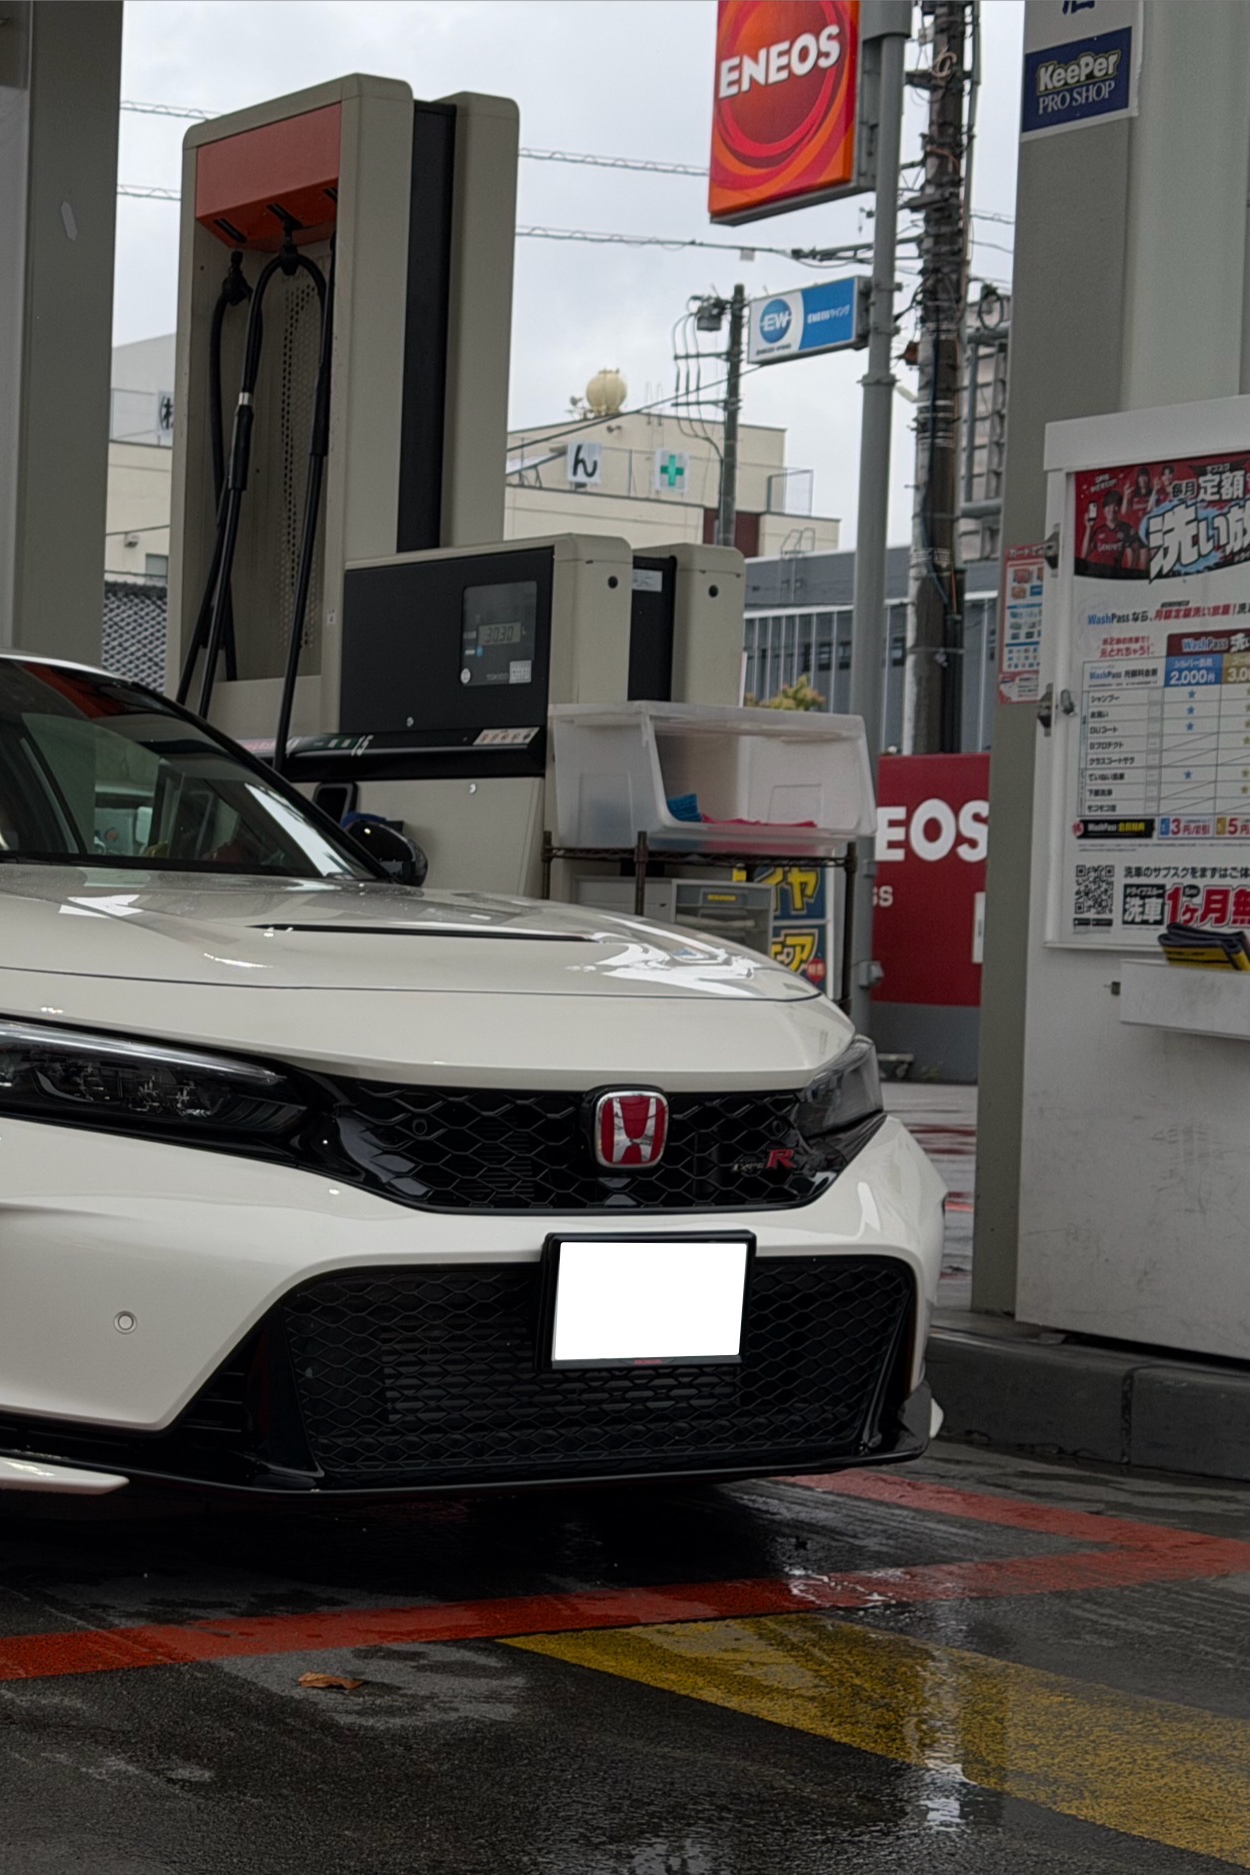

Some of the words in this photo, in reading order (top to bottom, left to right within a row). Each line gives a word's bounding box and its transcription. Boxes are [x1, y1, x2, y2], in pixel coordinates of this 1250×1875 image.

[718, 24, 841, 99] ENEOS
[1038, 53, 1119, 92] KeePer
[1038, 91, 1070, 115] PRO
[1072, 80, 1115, 106] SHOP
[1227, 667, 1250, 682] 3,0
[1124, 897, 1163, 924] 洗車
[766, 1148, 795, 1169] R
